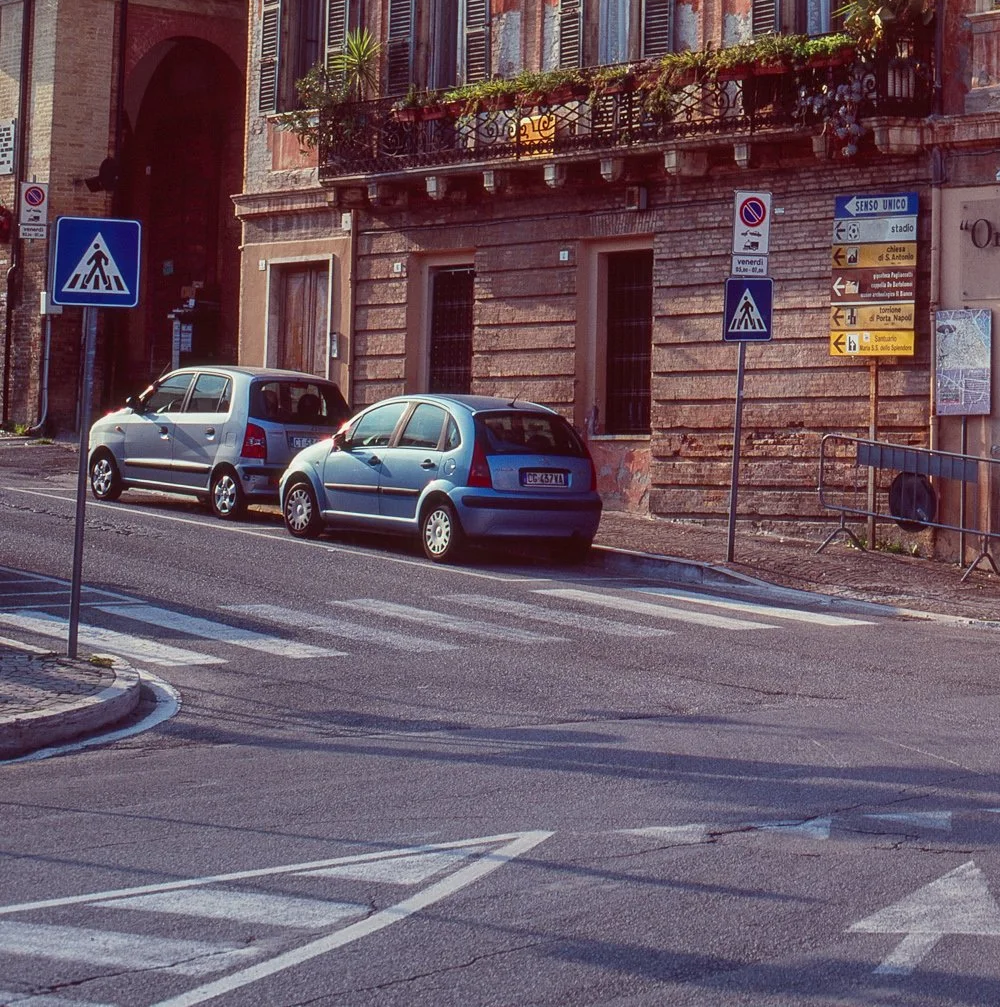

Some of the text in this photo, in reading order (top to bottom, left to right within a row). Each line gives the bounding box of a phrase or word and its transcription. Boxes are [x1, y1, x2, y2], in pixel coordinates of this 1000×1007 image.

[855, 198, 906, 212] SENSO UNICO
[891, 223, 914, 233] stadio
[886, 245, 906, 253] chiesa
[878, 254, 884, 262] di
[892, 253, 914, 262] Antonio
[879, 306, 901, 314] torrione
[876, 314, 891, 322] Porta
[893, 313, 912, 323] Napoli
[891, 344, 912, 352] Splendore
